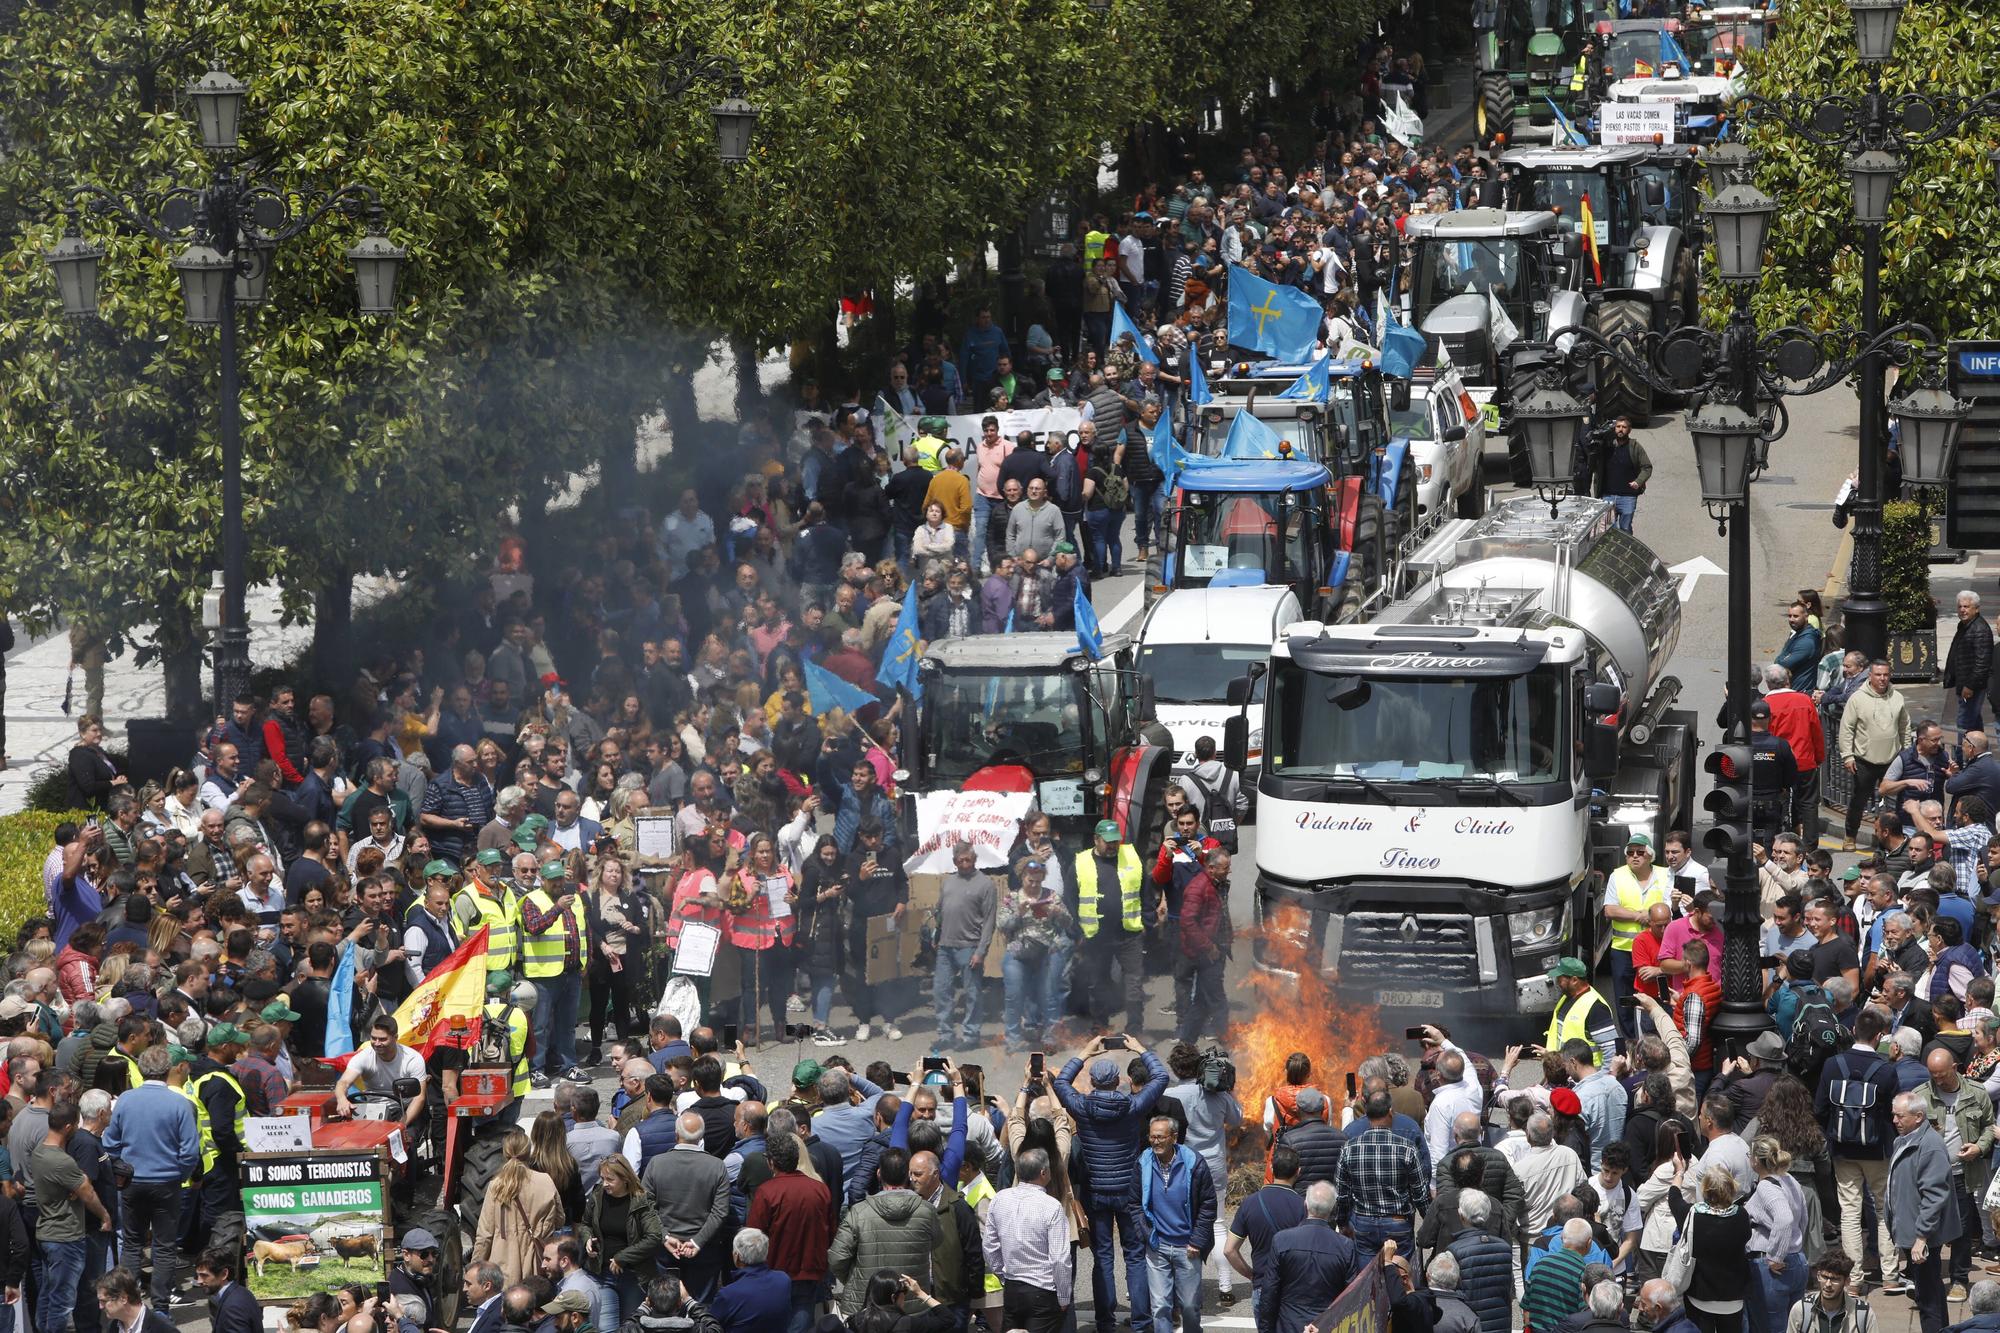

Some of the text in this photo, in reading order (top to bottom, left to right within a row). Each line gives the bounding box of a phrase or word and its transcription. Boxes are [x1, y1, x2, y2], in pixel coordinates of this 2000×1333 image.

[1616, 111, 1660, 119] LAS VACAS COMEN
[1624, 123, 1641, 131] PASTOS
[1617, 135, 1623, 143] NO
[1370, 652, 1487, 669] Tineo
[962, 797, 996, 808] CAMPO
[977, 813, 1012, 828] CAMPO
[1209, 818, 1236, 832] VANS
[1404, 816, 1421, 833] &
[1454, 816, 1515, 835] Olvido
[1380, 847, 1441, 870] Tineo
[249, 1161, 372, 1182] NO SOMOS TERRORISTAS
[252, 1188, 372, 1209] SOMOS GANADEROS
